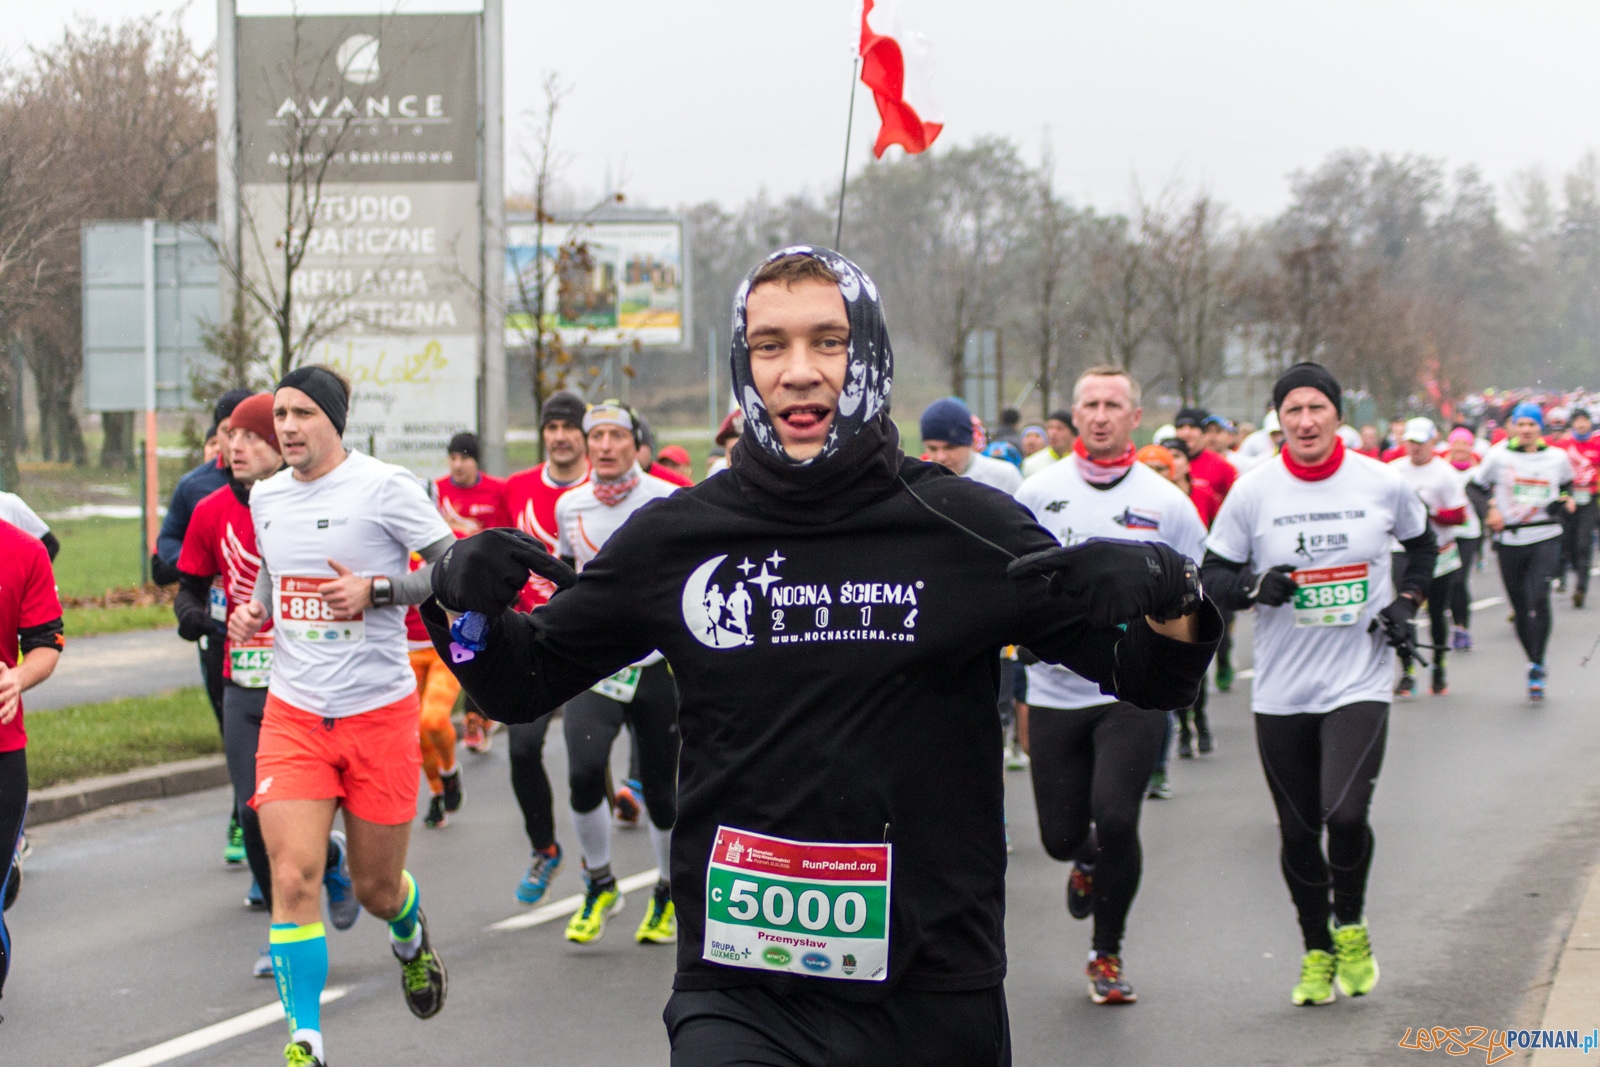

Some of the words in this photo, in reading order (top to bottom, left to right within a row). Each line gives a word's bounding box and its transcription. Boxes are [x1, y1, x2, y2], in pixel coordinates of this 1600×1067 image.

[276, 95, 443, 118] AVANCE
[1345, 510, 1366, 519] TEAM
[1327, 533, 1349, 546] RUN
[772, 584, 832, 607] NOCNA
[1302, 583, 1365, 608] 3896
[289, 597, 353, 621] 888
[772, 630, 915, 644] www.NOCNASCIEMA.com
[802, 860, 877, 873] RunPoland.org
[727, 878, 867, 933] 5000
[711, 940, 735, 952] GRUPA
[757, 931, 827, 948] Przemysław
[711, 948, 741, 961] LUXMED
